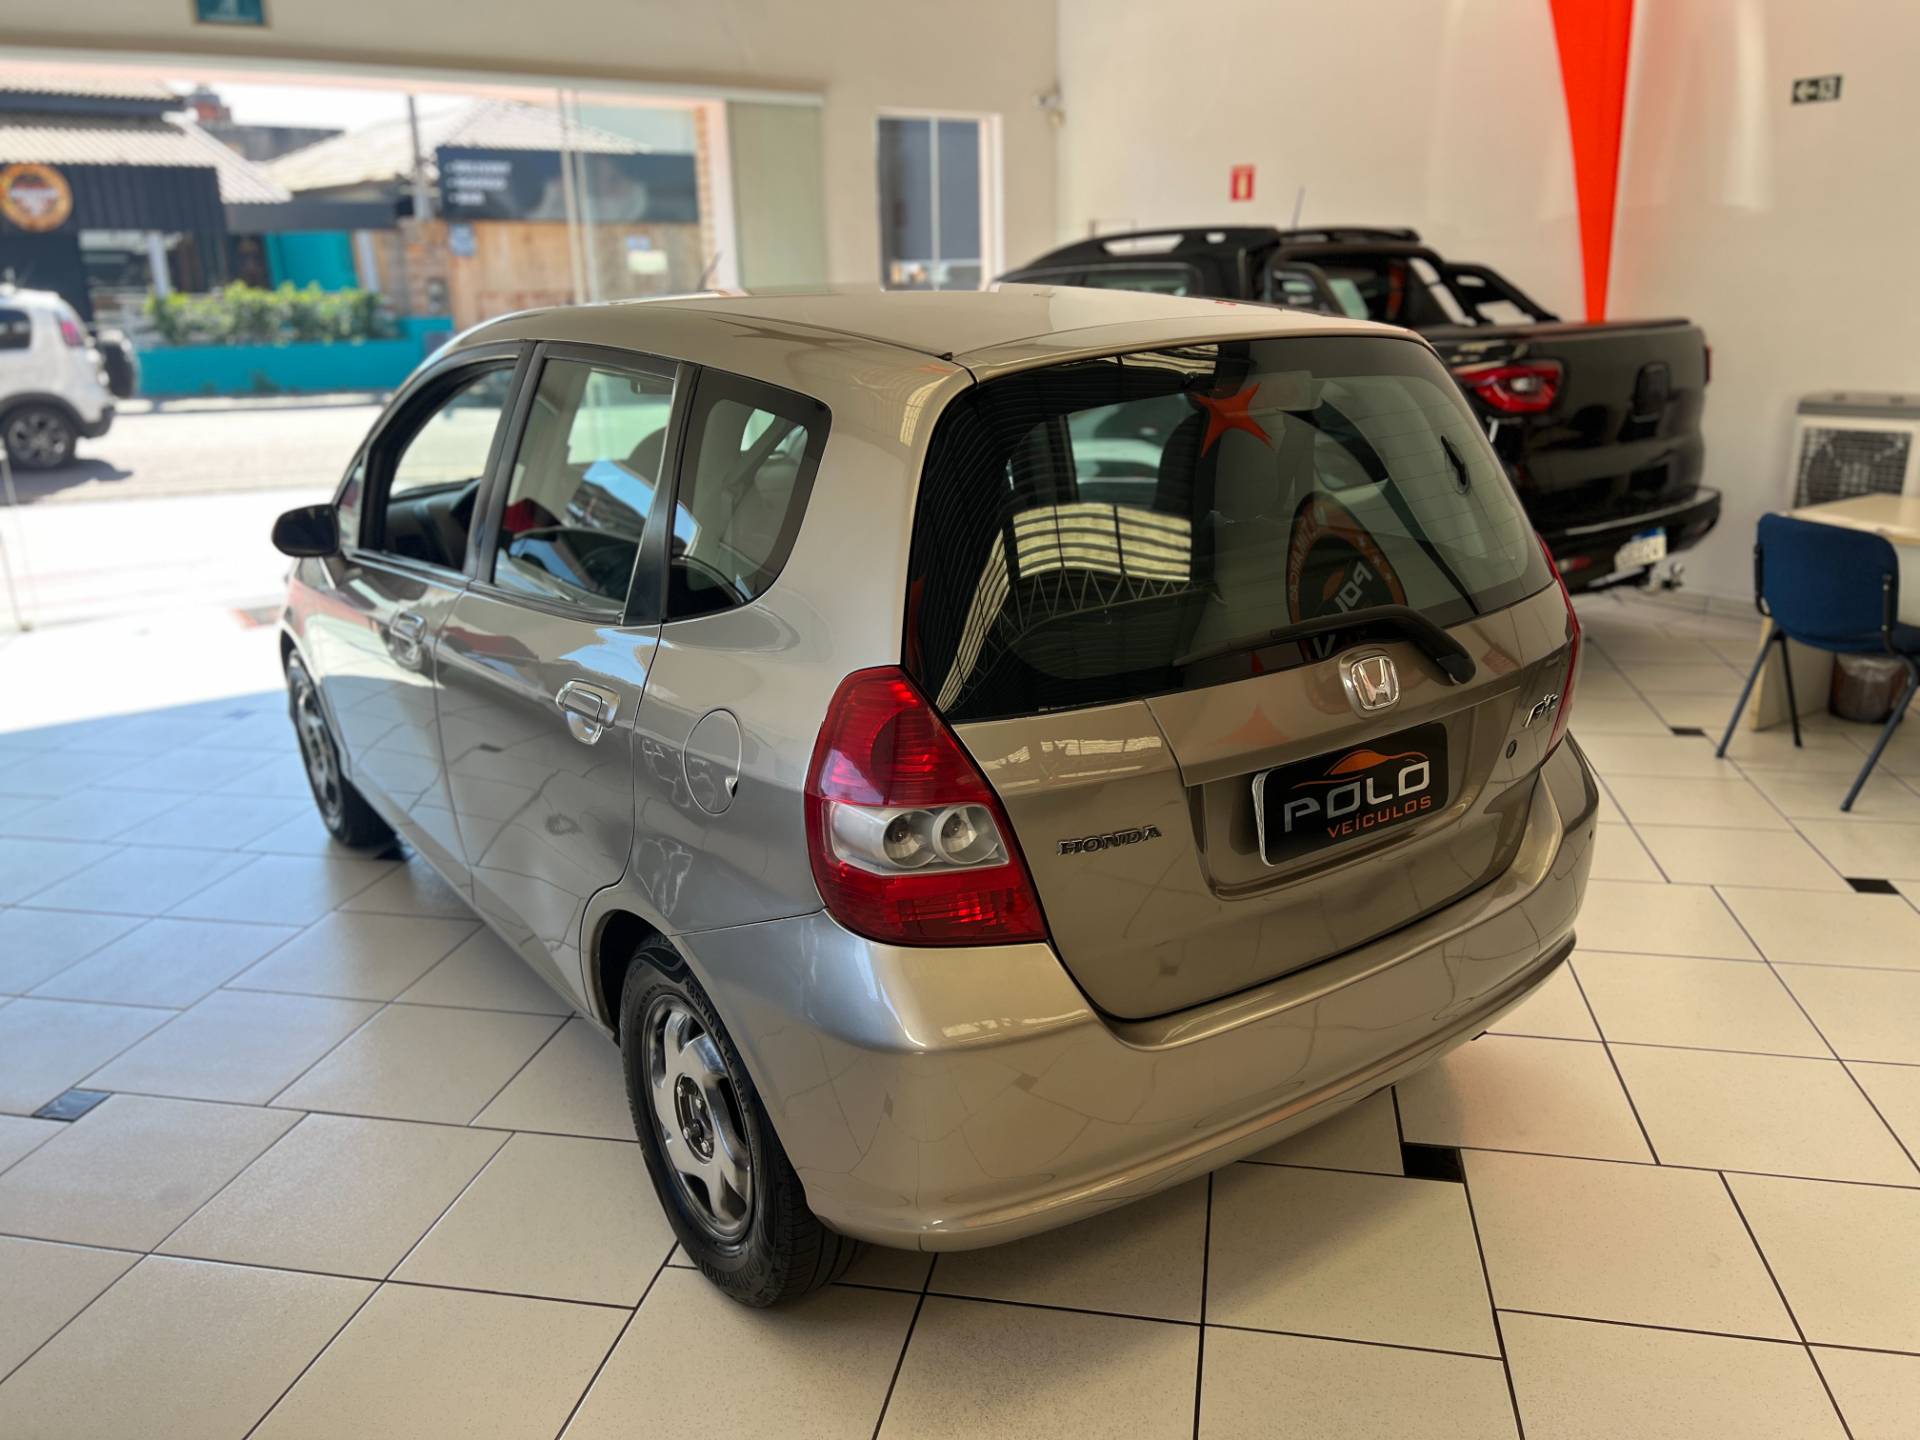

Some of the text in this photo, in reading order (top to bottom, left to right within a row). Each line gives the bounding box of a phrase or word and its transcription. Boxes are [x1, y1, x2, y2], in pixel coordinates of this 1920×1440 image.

[1283, 760, 1431, 833] POLO
[1327, 795, 1433, 839] VEÍCULOS
[1056, 825, 1162, 856] HONDA
